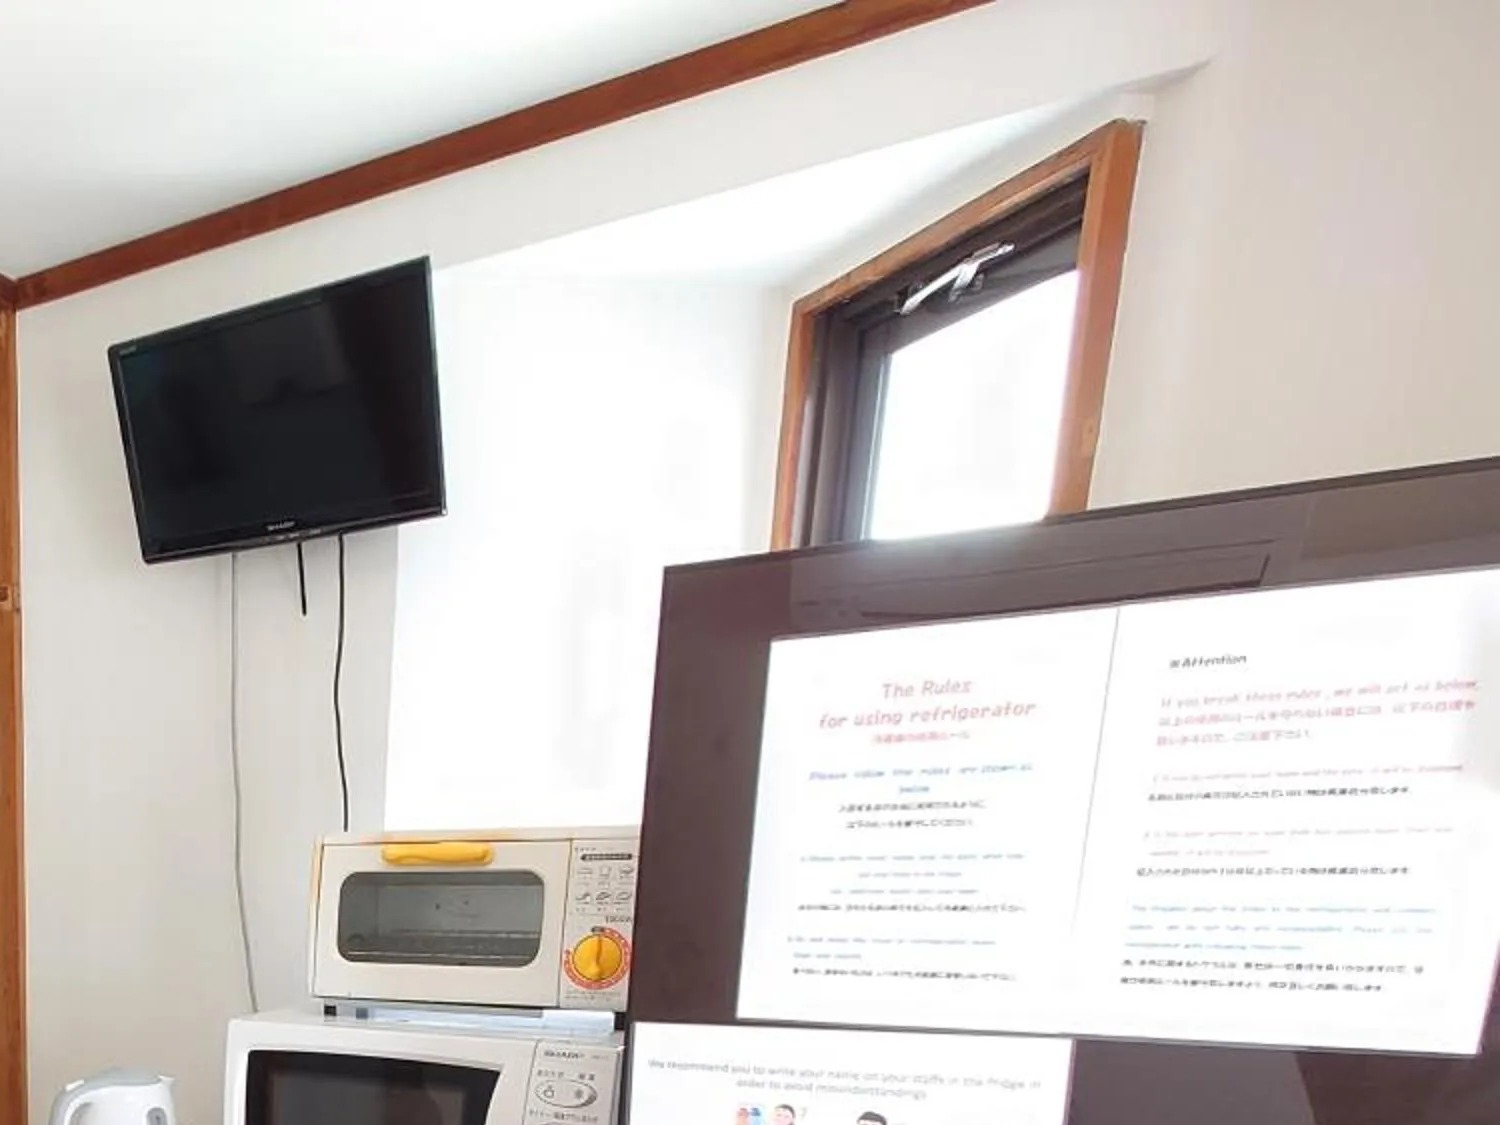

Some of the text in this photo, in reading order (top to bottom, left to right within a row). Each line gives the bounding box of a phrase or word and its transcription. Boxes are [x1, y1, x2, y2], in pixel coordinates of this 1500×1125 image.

[882, 678, 974, 699] The Rules
[818, 700, 1038, 730] for using refrigerator
[667, 1061, 729, 1074] recommend
